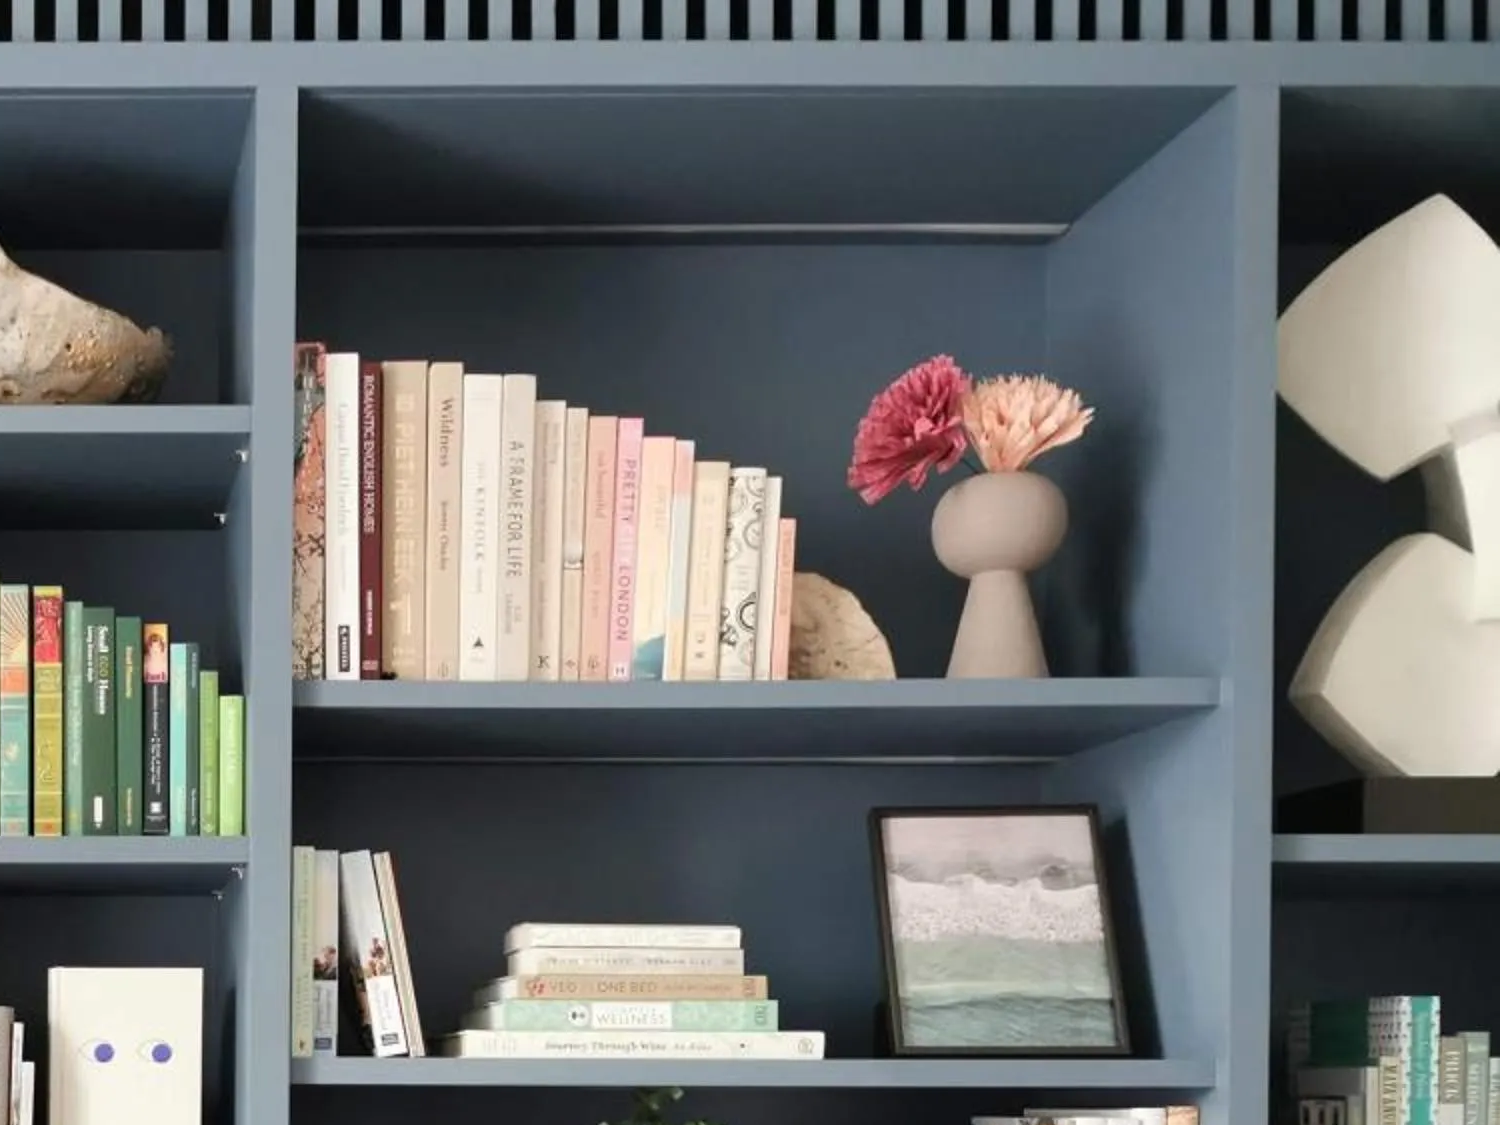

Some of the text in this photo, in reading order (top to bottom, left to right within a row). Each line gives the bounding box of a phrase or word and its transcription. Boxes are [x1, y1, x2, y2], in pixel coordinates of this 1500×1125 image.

[440, 397, 455, 469] Wildness
[510, 440, 525, 453] A
[395, 480, 414, 532] HEIN
[508, 457, 525, 510] FRAME
[507, 512, 524, 542] FOR
[614, 459, 637, 643] PRETTY LONDON
[396, 539, 414, 584] EEK
[506, 547, 523, 579] LIFE
